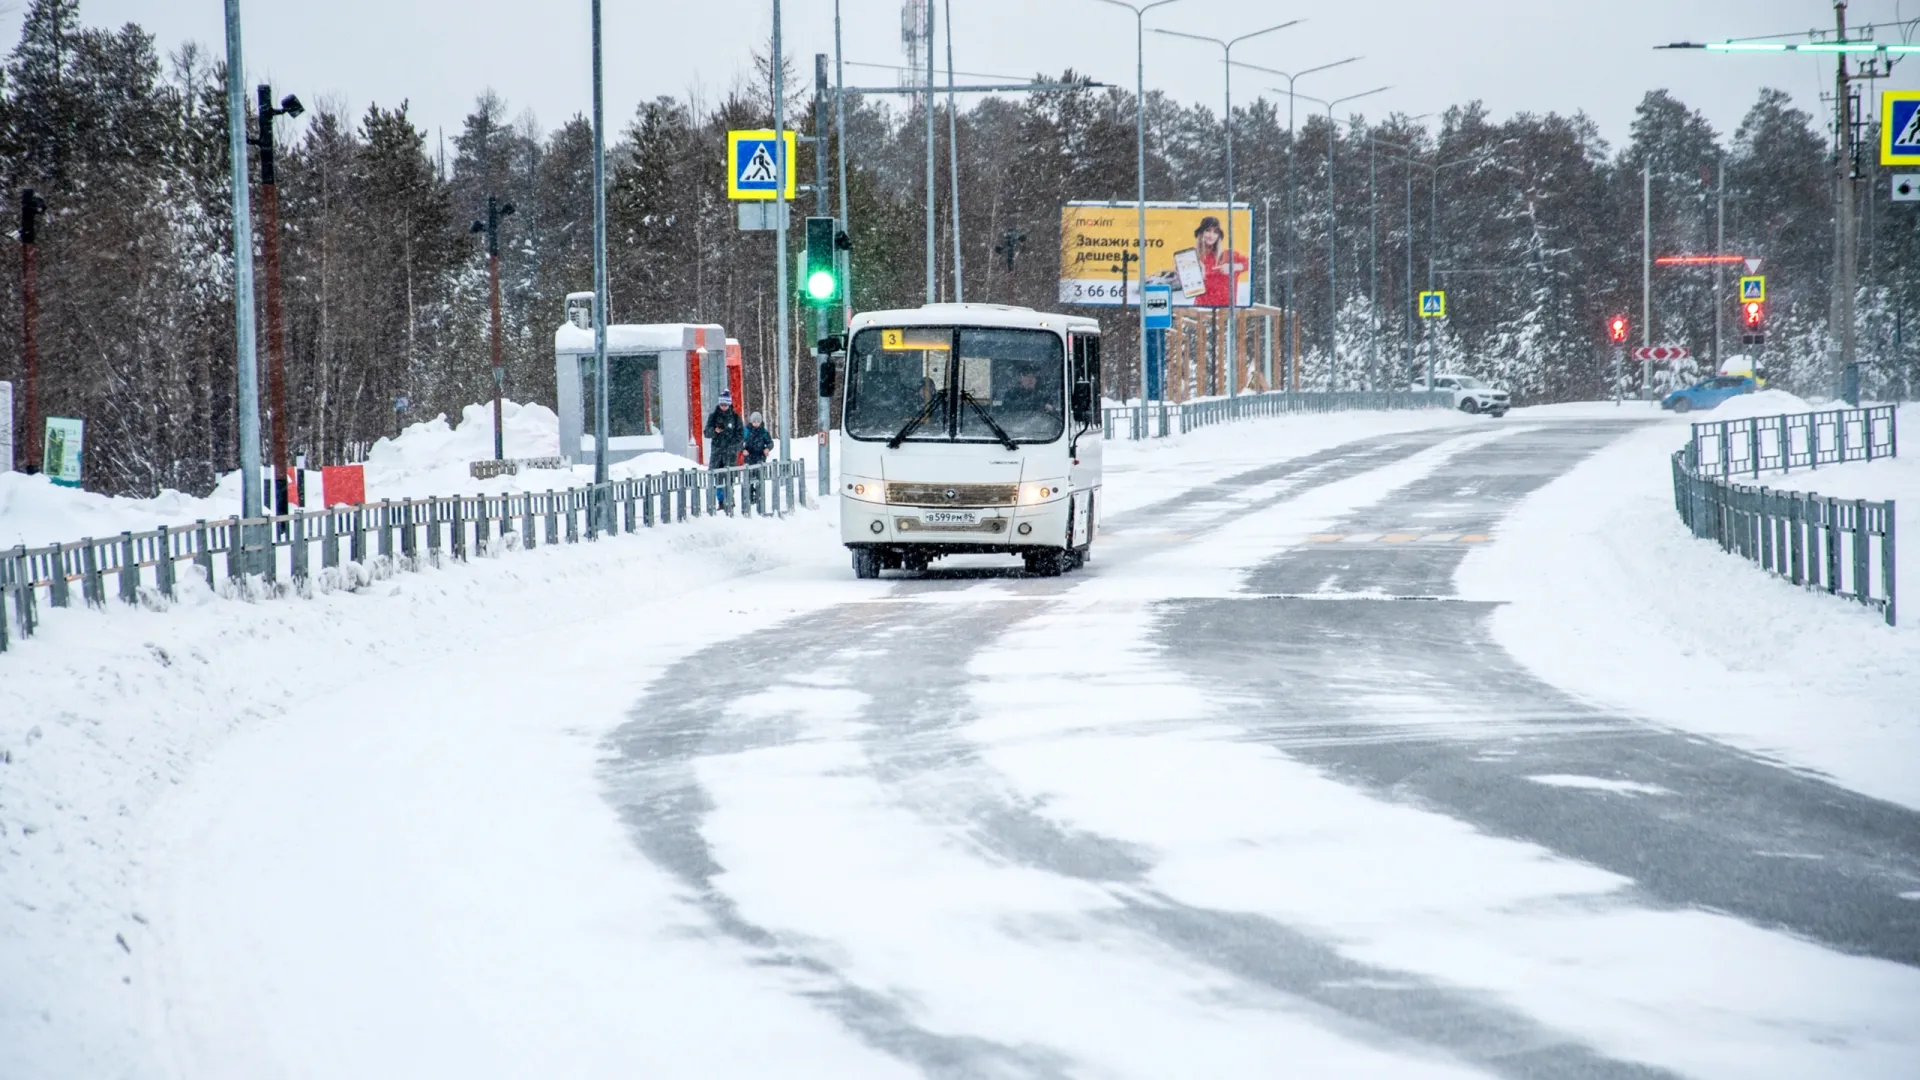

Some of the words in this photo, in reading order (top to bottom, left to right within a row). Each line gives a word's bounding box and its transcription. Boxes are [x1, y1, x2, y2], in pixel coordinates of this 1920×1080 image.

[1076, 234, 1129, 248] Закажи
[1075, 251, 1138, 263] дешев
[888, 334, 896, 345] 3
